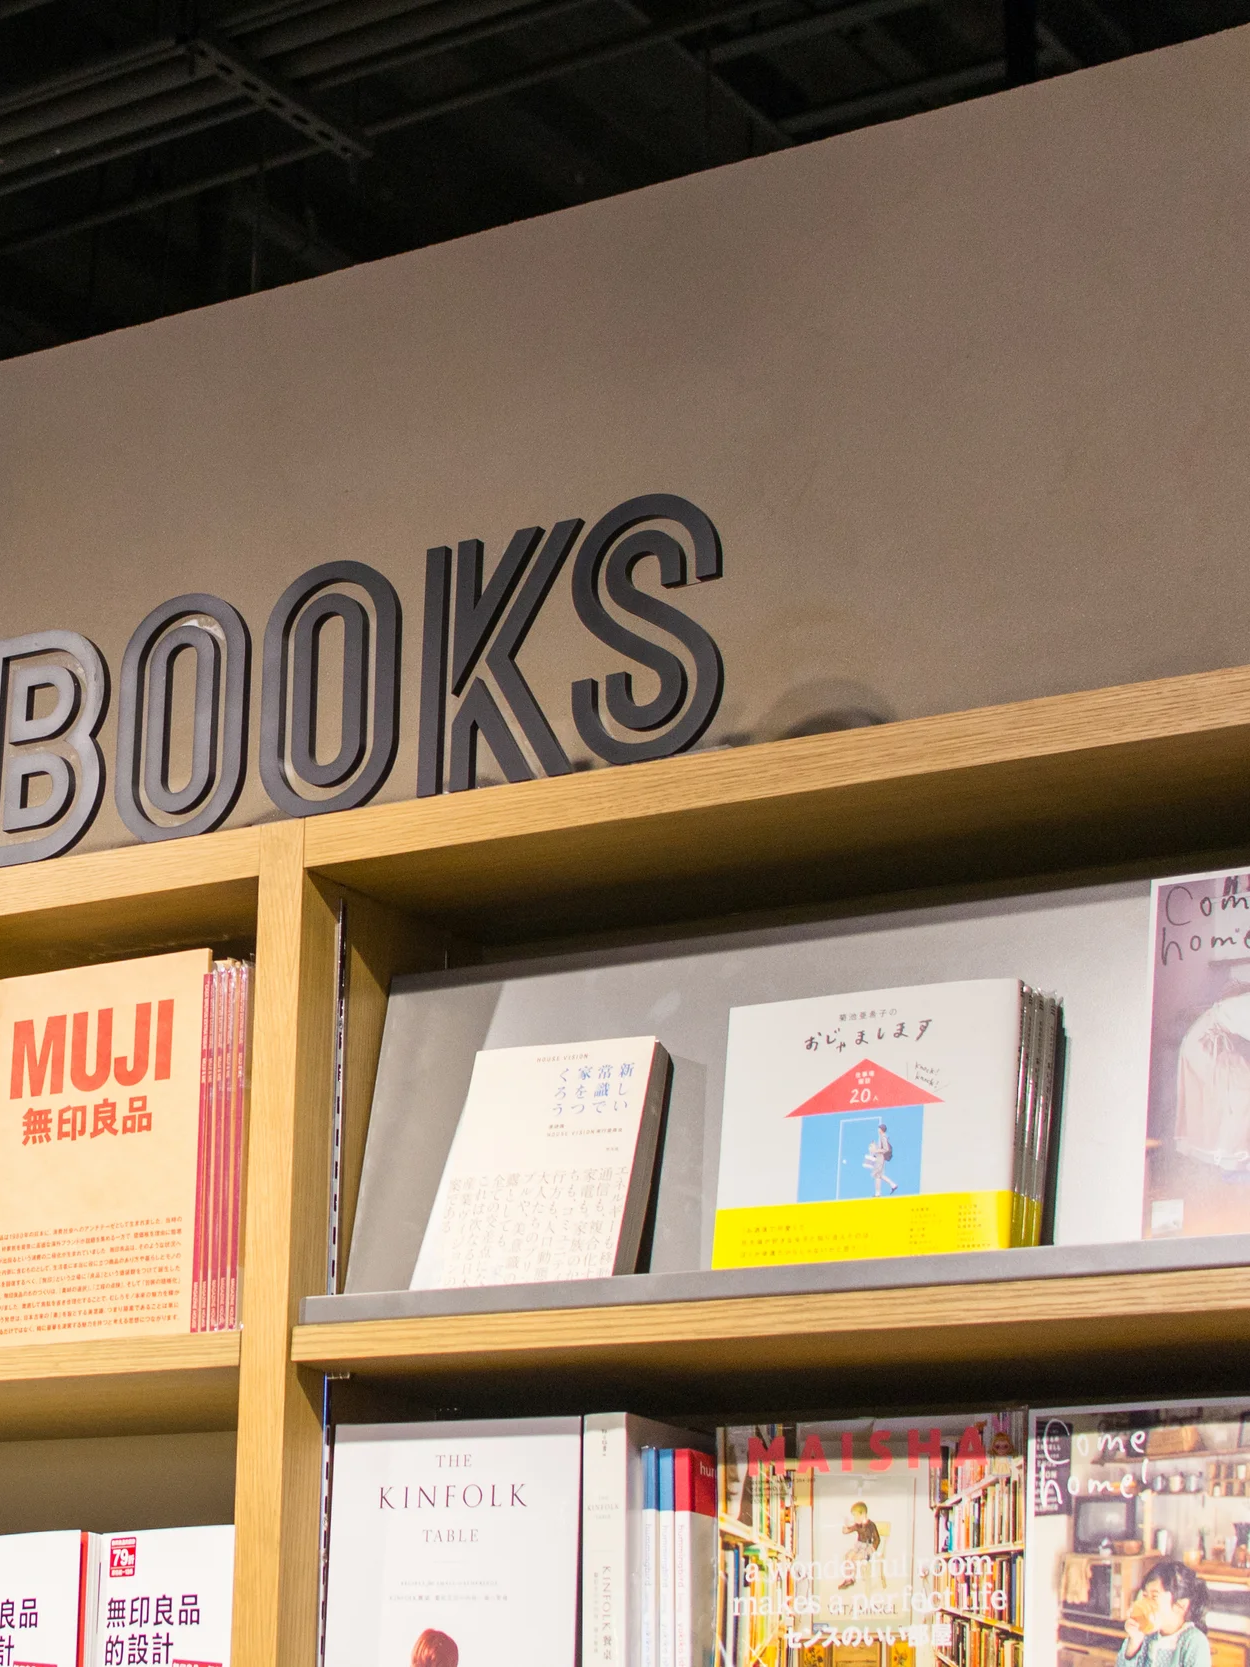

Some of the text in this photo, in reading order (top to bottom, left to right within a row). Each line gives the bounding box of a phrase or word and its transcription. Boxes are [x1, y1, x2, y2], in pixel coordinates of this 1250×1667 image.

[9, 1000, 175, 1100] MUJI
[804, 1019, 932, 1053] おじゃまします
[552, 1068, 569, 1117] くろう
[571, 1065, 593, 1114] 家をつ
[614, 1062, 635, 1112] 新しい
[22, 1097, 153, 1146] 無印良品
[435, 1454, 473, 1468] THE
[748, 1426, 989, 1477] MAISHA
[1043, 1418, 1147, 1464] Come
[378, 1483, 528, 1510] KINFOLK
[1040, 1458, 1150, 1508] home!
[587, 1502, 619, 1511] KINFOLK
[422, 1529, 479, 1543] TABLE
[643, 1523, 652, 1587] hummingbird
[661, 1525, 669, 1589] hummingbird
[677, 1524, 685, 1588] hummingbird
[745, 1551, 994, 1585] a wonderful room
[106, 1594, 200, 1629] 無印良品
[732, 1582, 1008, 1620] makes a perfect life
[104, 1632, 174, 1666] 的設計
[786, 1623, 953, 1650] センスのいい部屋
